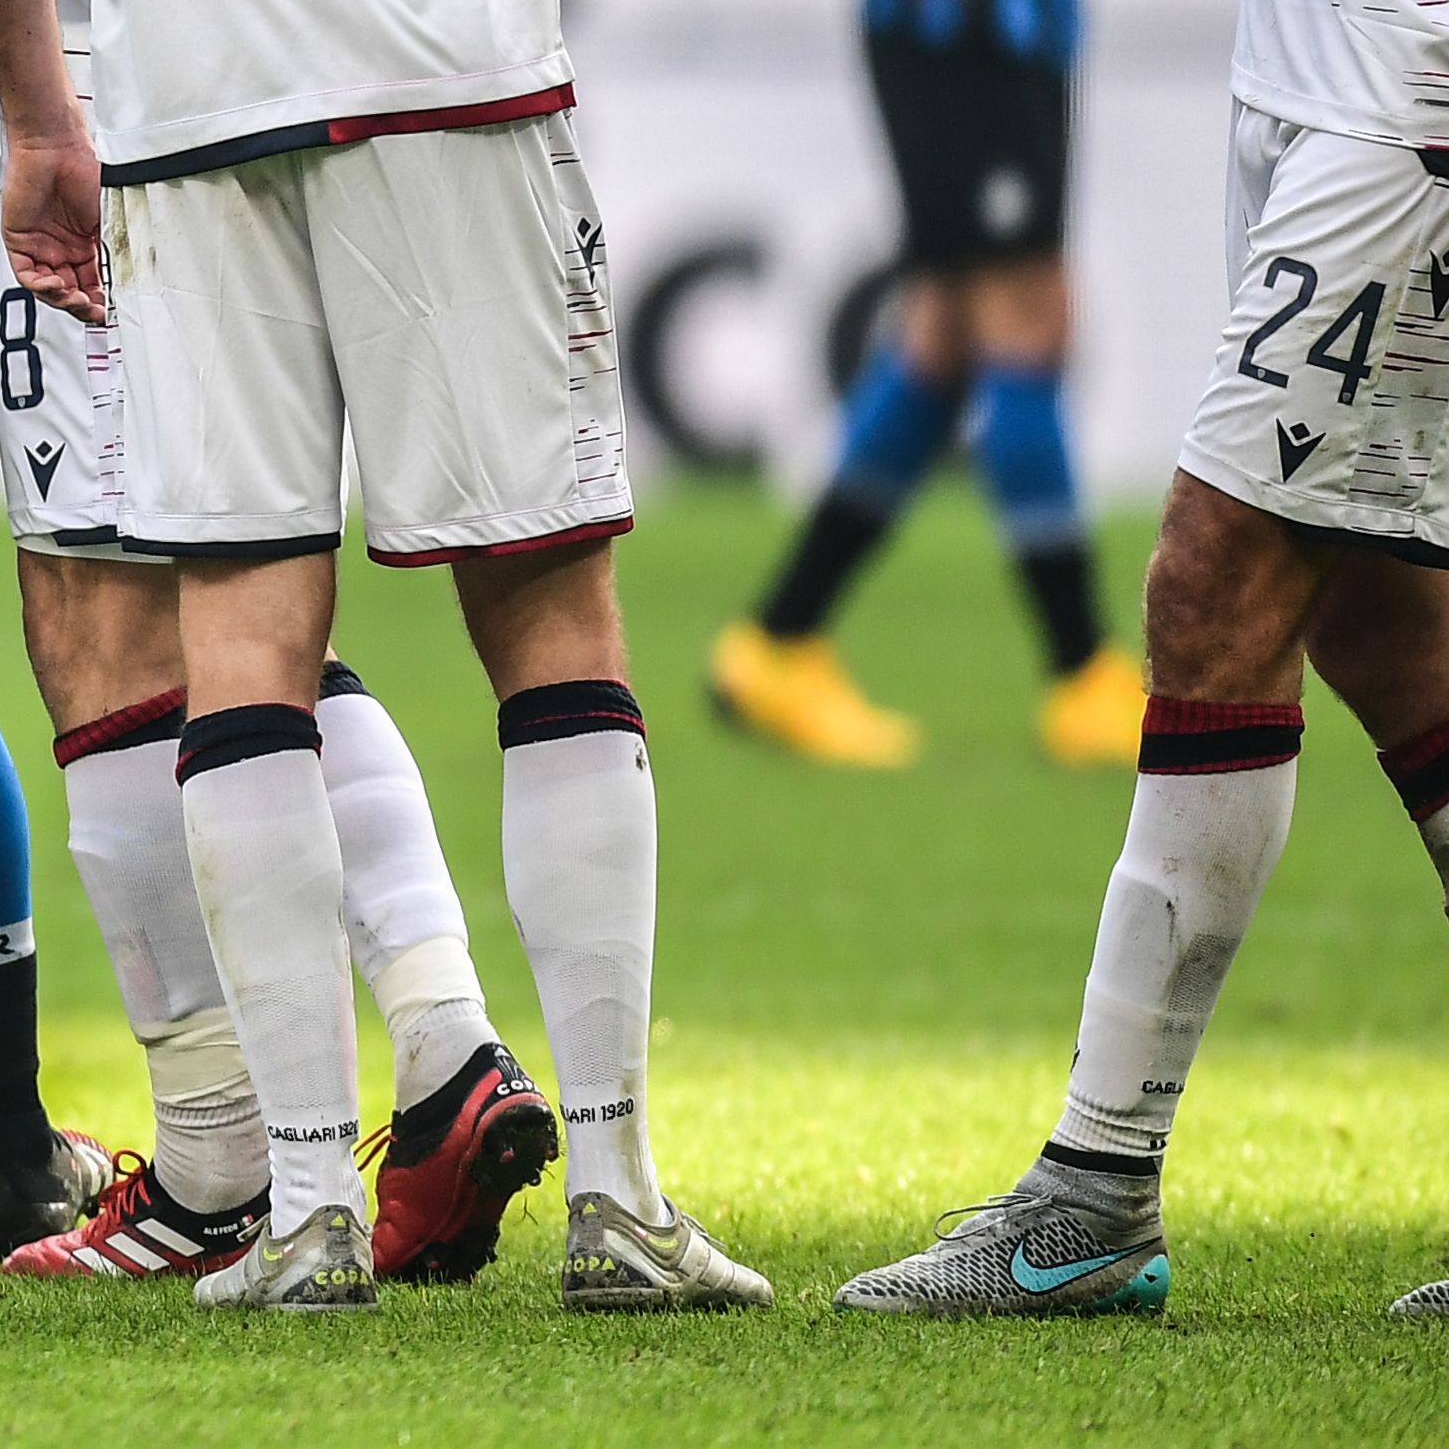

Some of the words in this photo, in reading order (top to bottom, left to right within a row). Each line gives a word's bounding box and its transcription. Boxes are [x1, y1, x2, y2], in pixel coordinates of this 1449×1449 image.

[1237, 255, 1387, 406] 24
[601, 1097, 634, 1122] 1920
[267, 1125, 336, 1143] CAGLIARI
[315, 1269, 370, 1287] COPA
